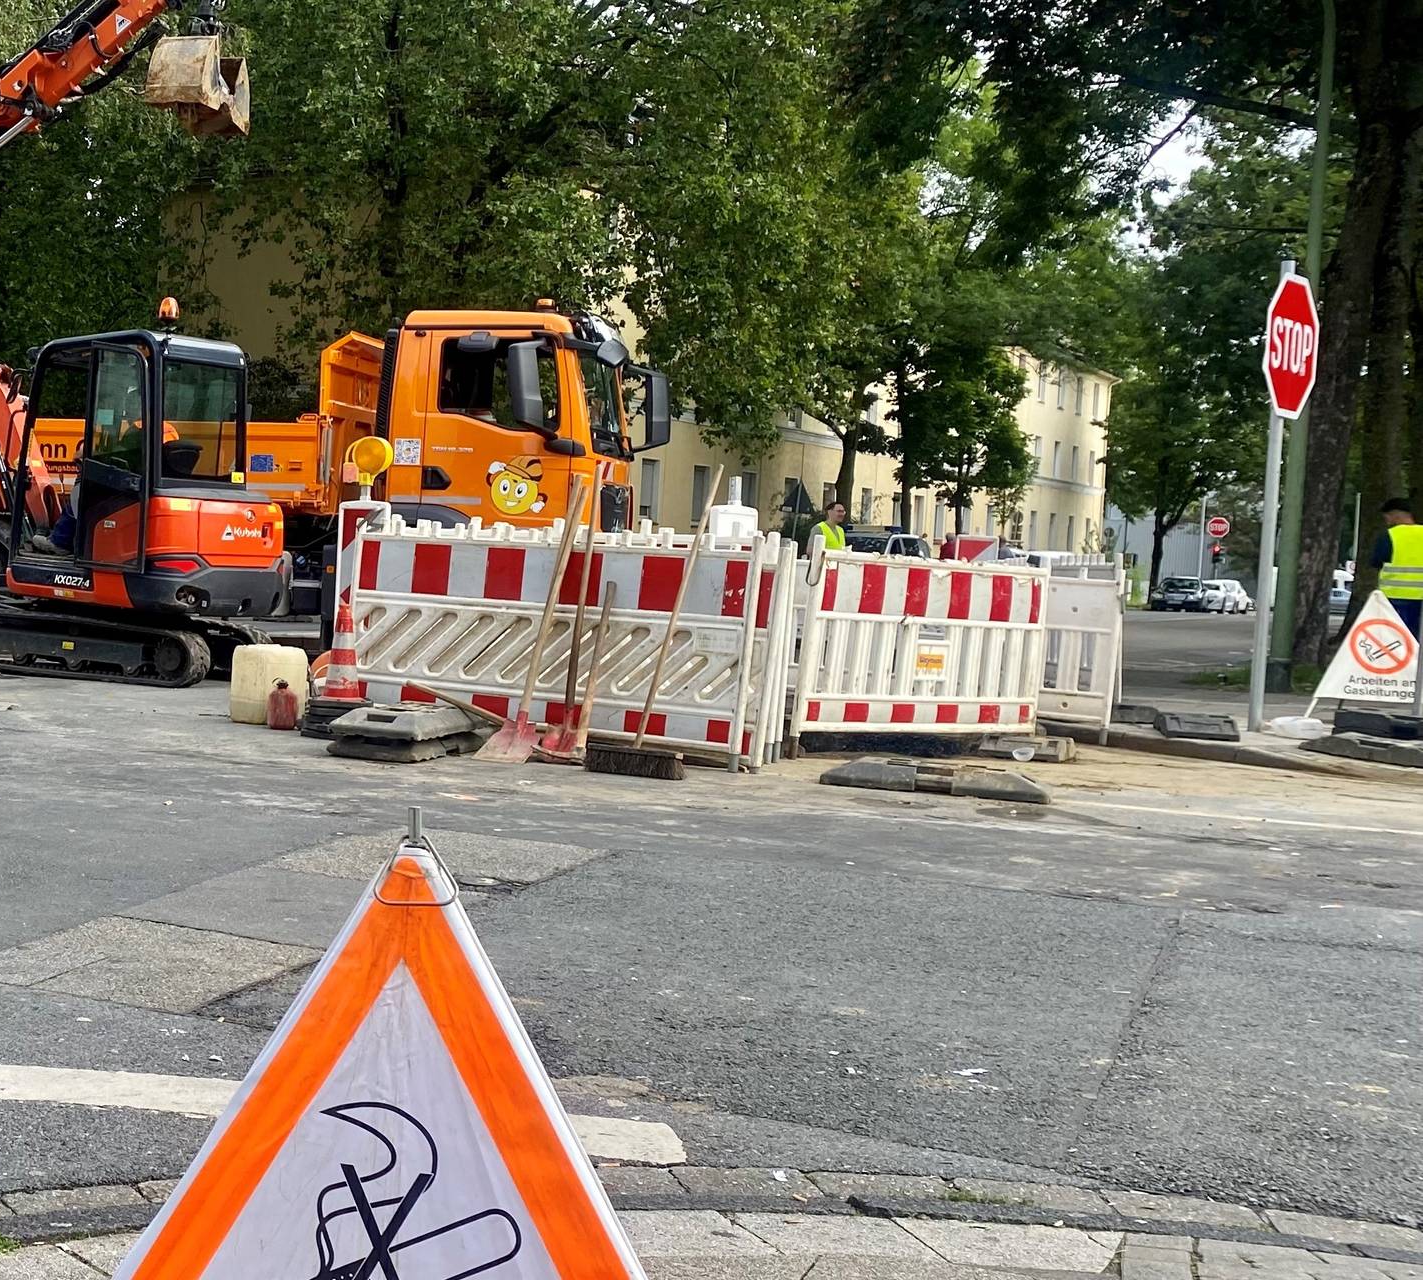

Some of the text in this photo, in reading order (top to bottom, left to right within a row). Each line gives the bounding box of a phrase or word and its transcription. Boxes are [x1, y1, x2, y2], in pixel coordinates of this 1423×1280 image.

[1270, 315, 1314, 377] STOP
[233, 526, 262, 539] Kubota
[1209, 523, 1228, 532] STOP
[54, 574, 90, 588] KX027-4
[1348, 675, 1398, 687] Arbeiten
[1343, 685, 1416, 700] Gasleitunge
